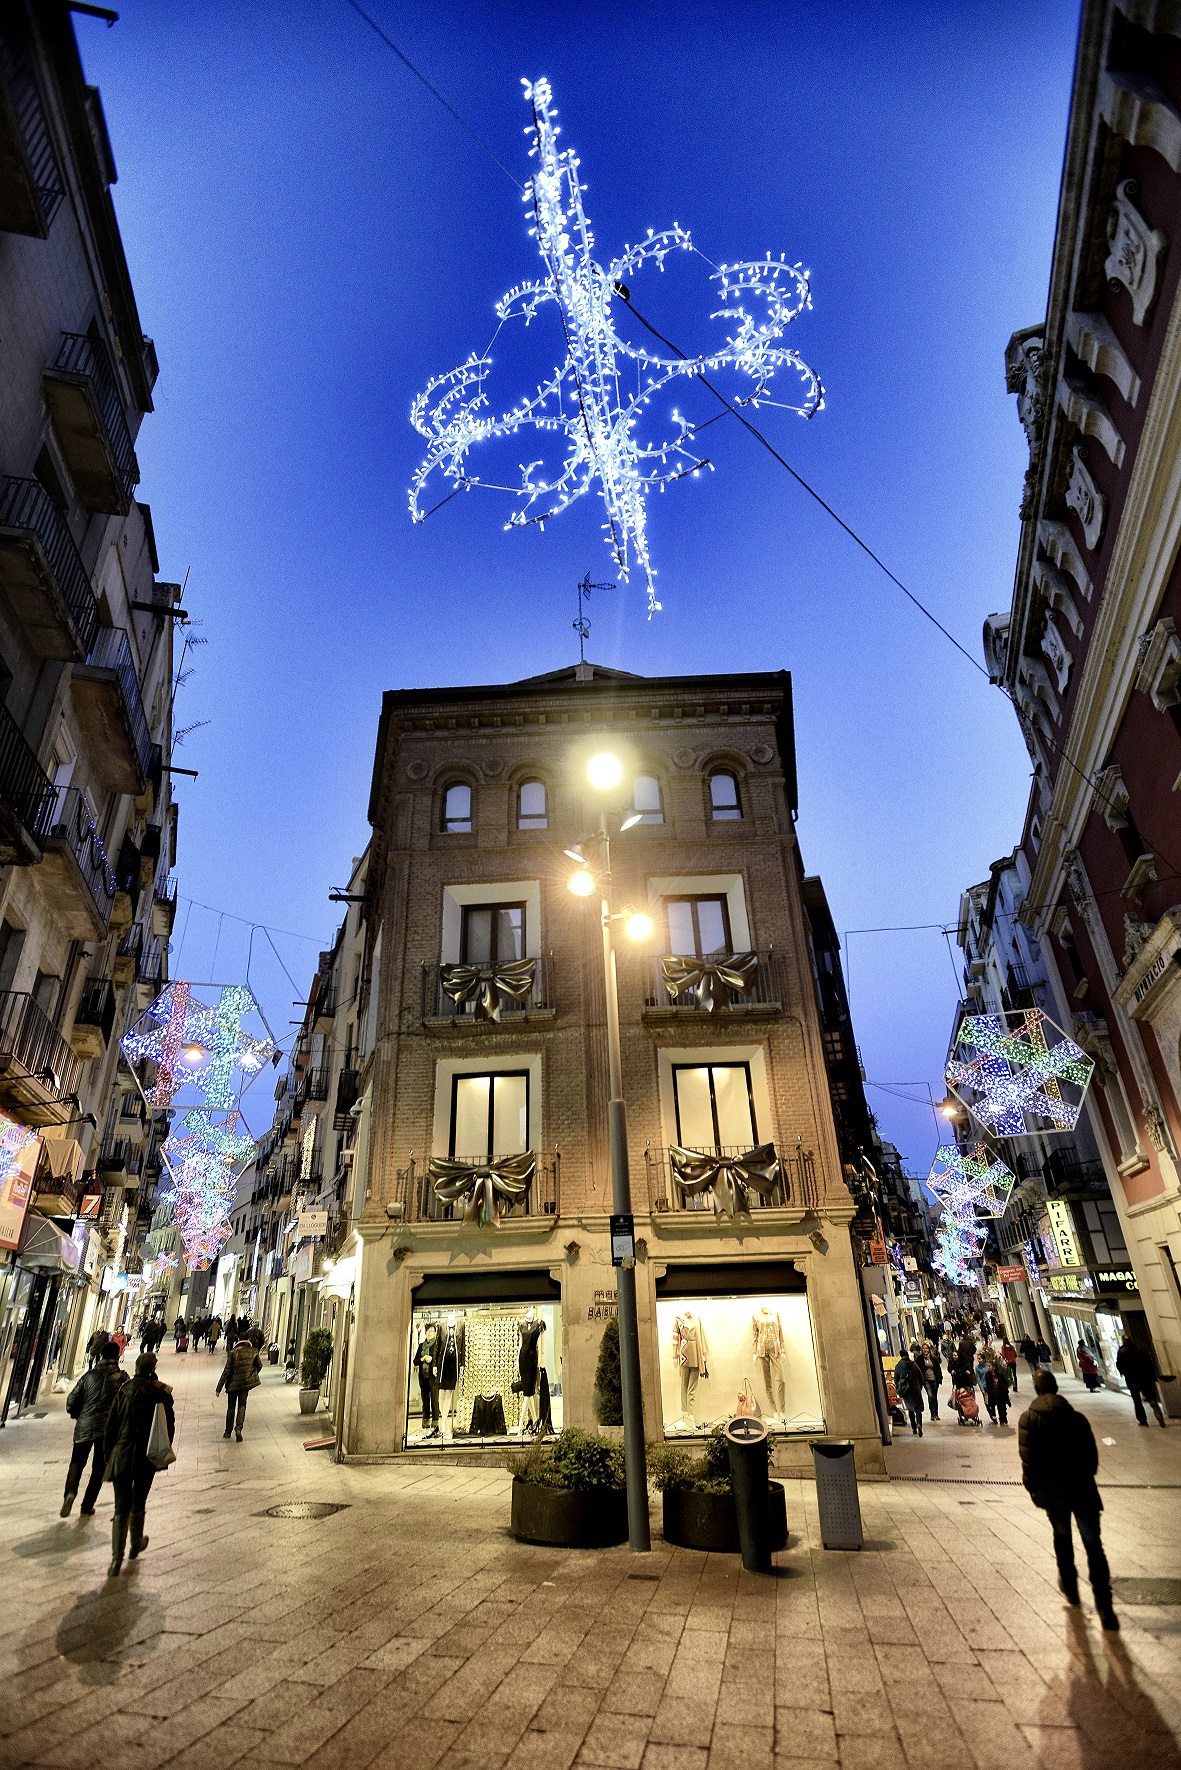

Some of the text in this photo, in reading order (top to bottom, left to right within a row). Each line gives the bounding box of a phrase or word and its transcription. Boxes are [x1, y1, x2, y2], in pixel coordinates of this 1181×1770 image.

[1134, 953, 1165, 1003] DIPUTACIÓ
[84, 1195, 100, 1213] 7
[1050, 1202, 1076, 1265] PIFARRE
